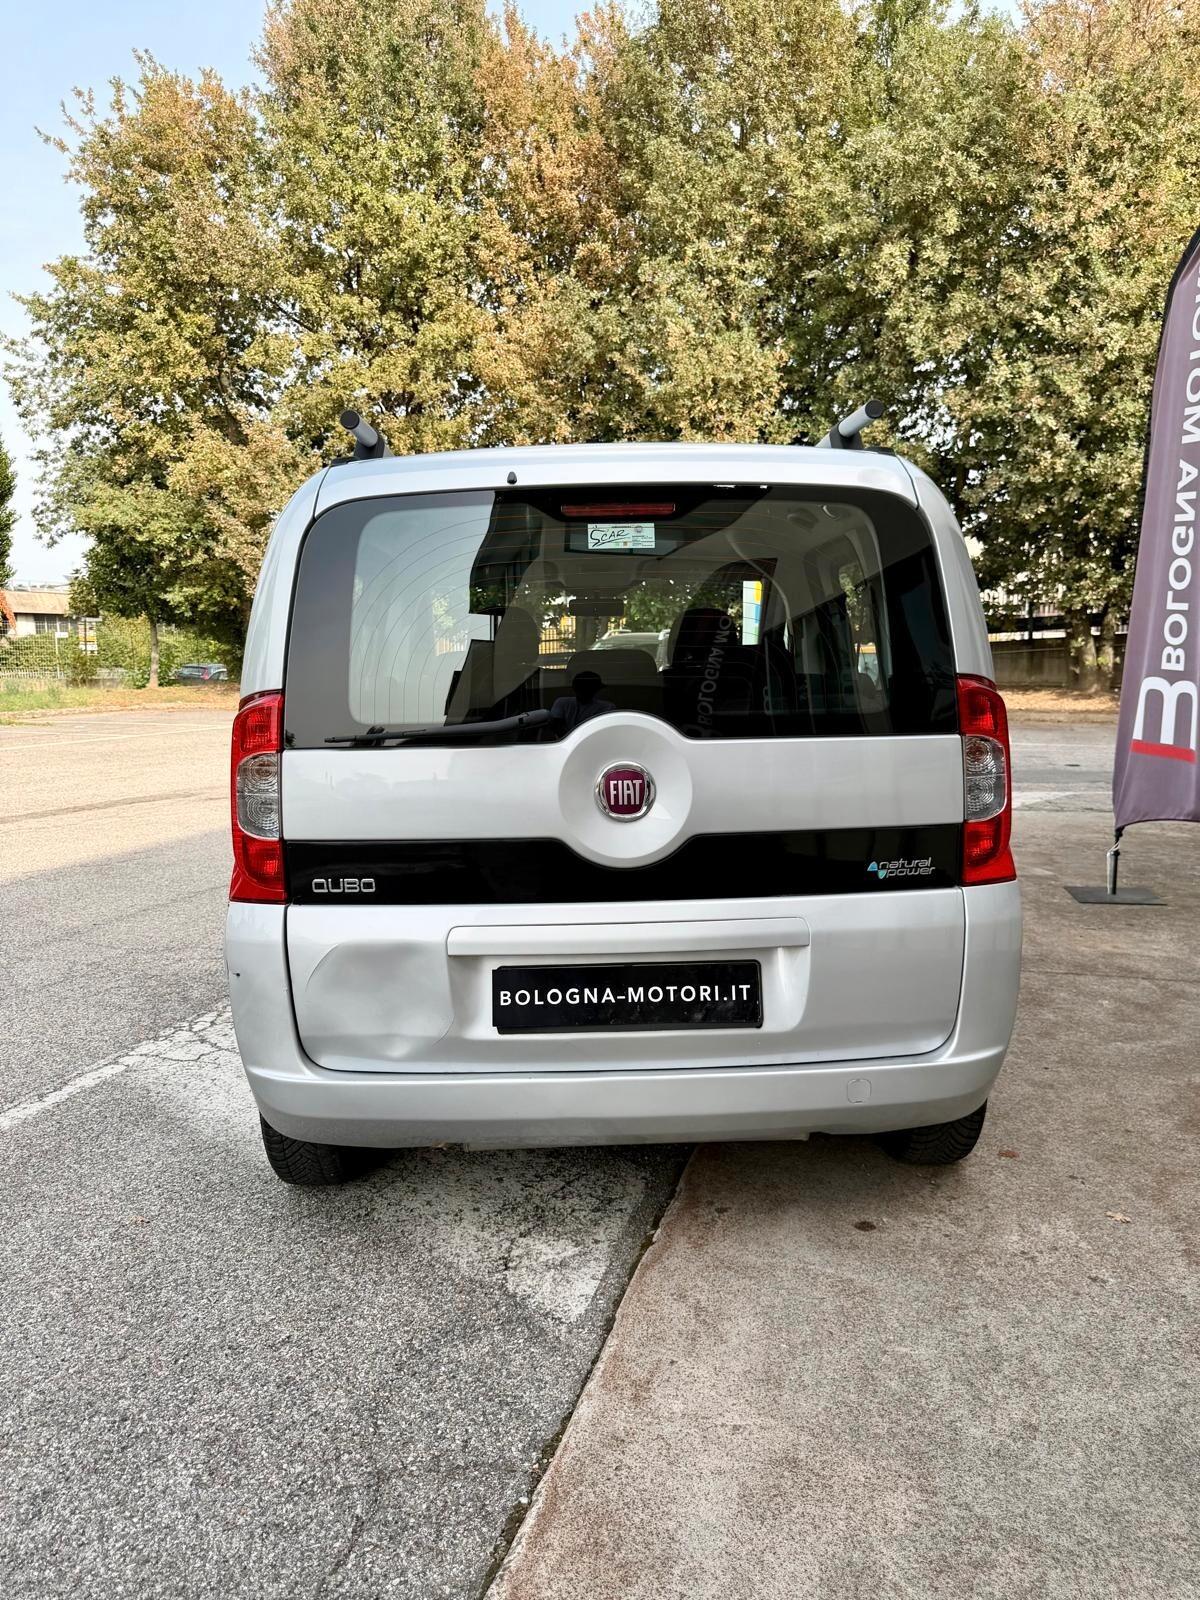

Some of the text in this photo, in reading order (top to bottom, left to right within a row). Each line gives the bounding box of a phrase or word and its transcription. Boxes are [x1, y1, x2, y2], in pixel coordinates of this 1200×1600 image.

[609, 779, 643, 806] FIAT
[879, 857, 932, 869] natural
[886, 867, 936, 878] power
[312, 878, 376, 893] QUBO
[500, 984, 751, 1006] BOLOGNA-MOTORI.IT
